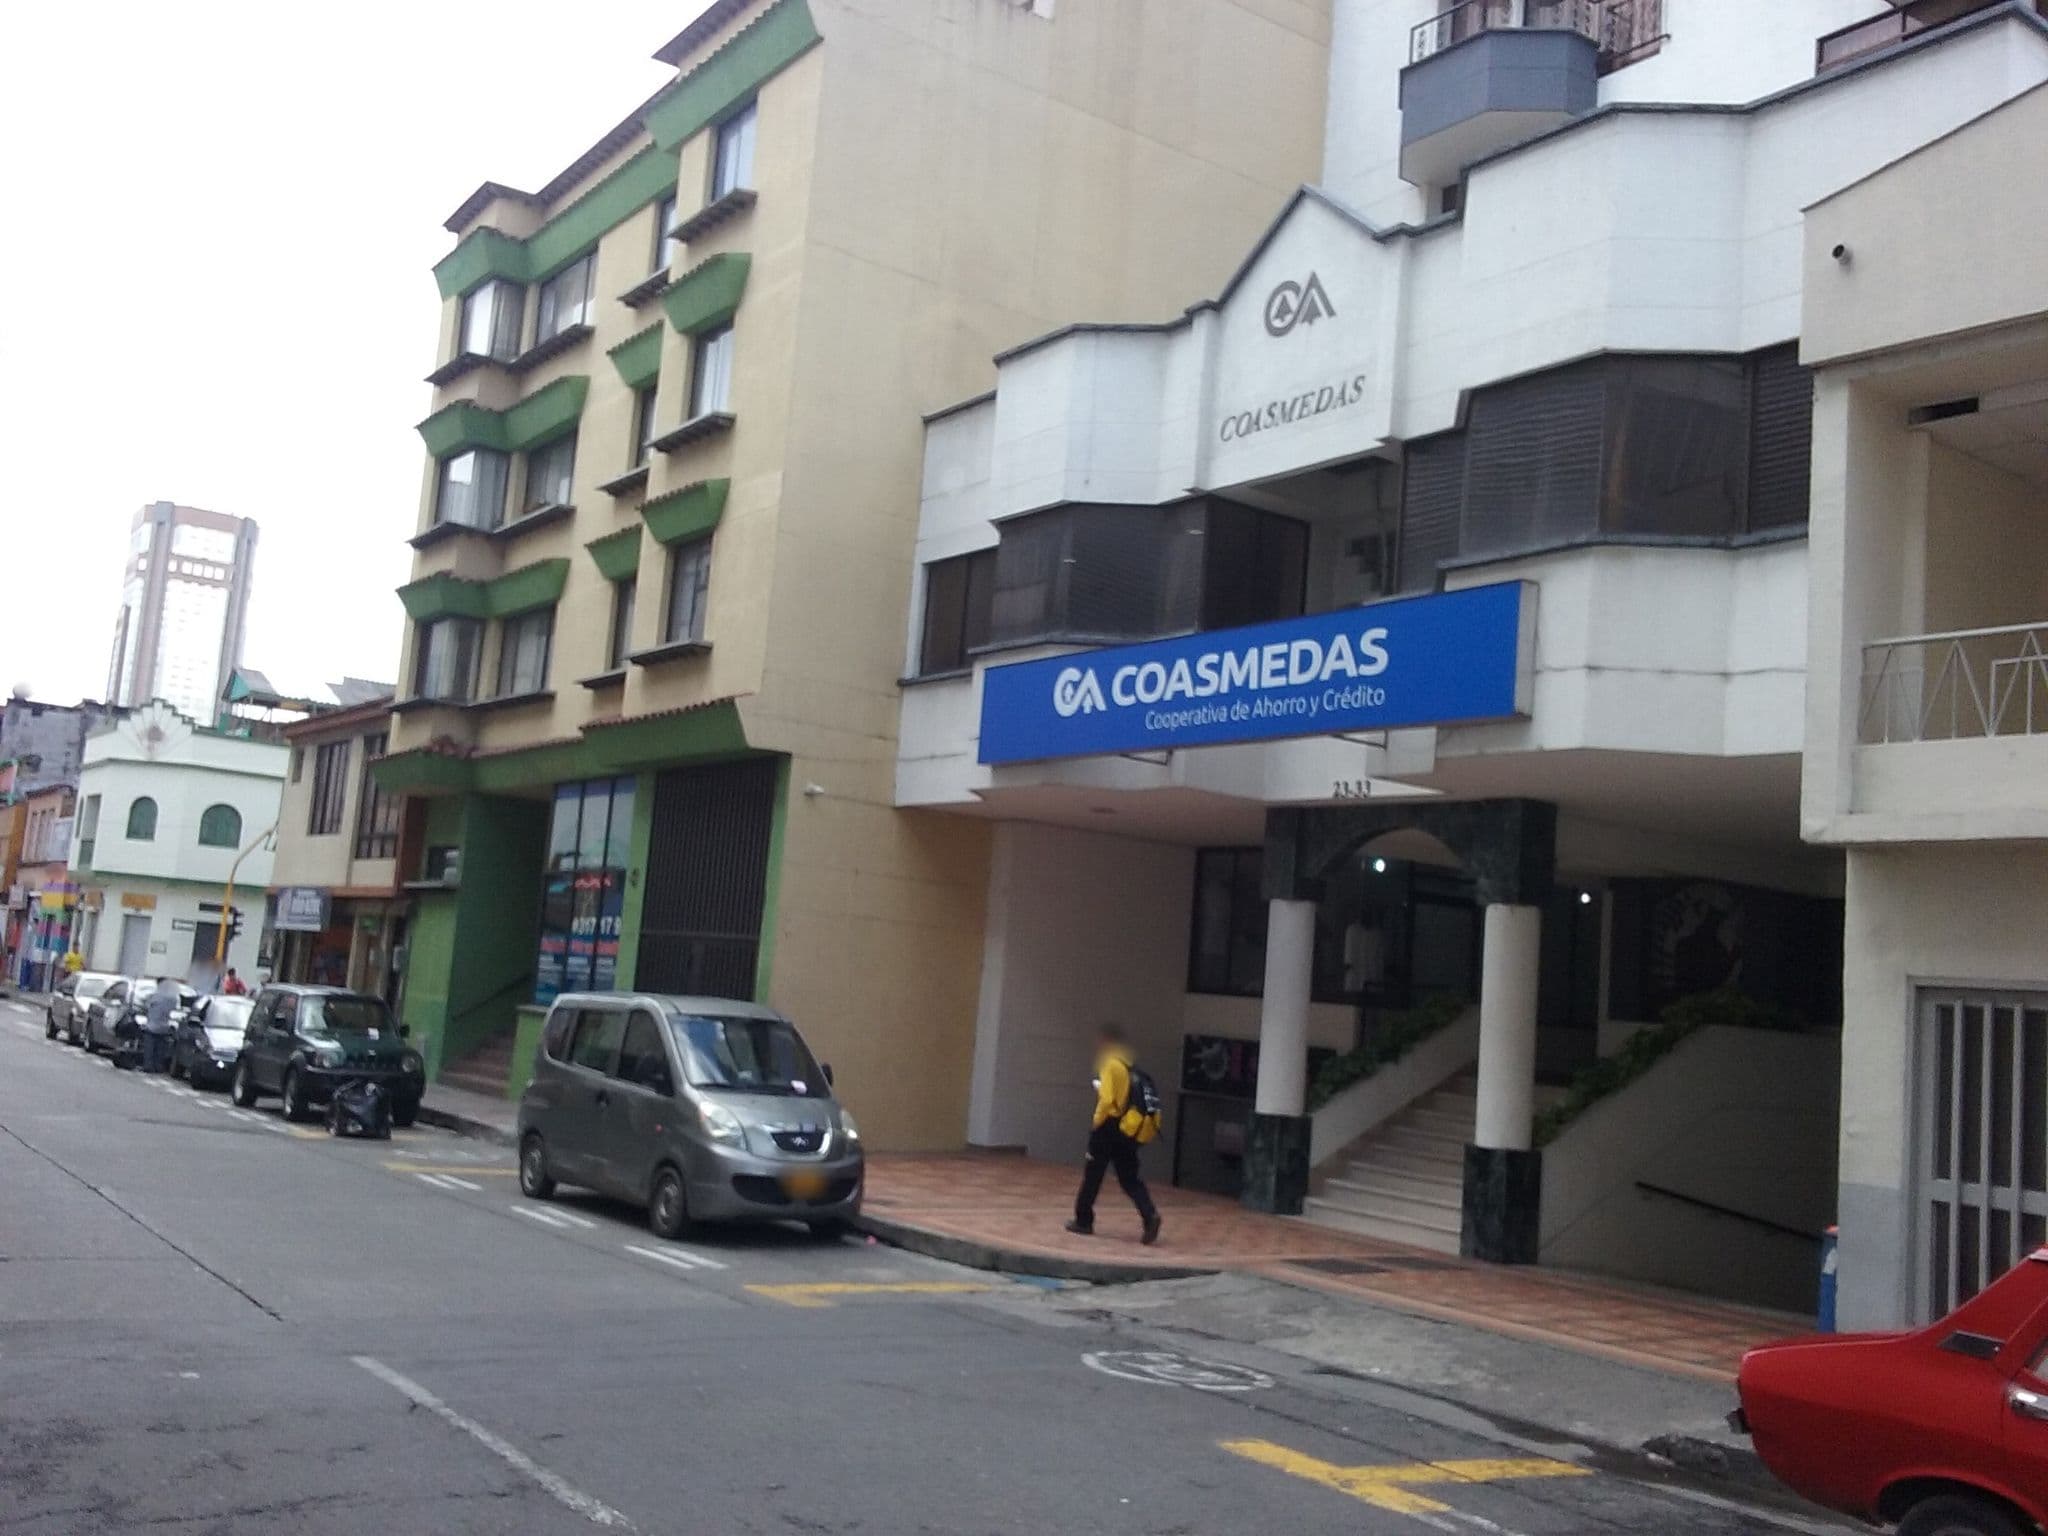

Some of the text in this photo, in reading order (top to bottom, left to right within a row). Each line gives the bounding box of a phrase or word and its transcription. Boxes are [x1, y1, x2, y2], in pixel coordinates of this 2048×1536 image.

[1219, 375, 1367, 442] COASMEDAS
[1111, 627, 1389, 707] COASMEDAS
[1144, 686, 1386, 731] Cooperativa de Ahorro y Crédito
